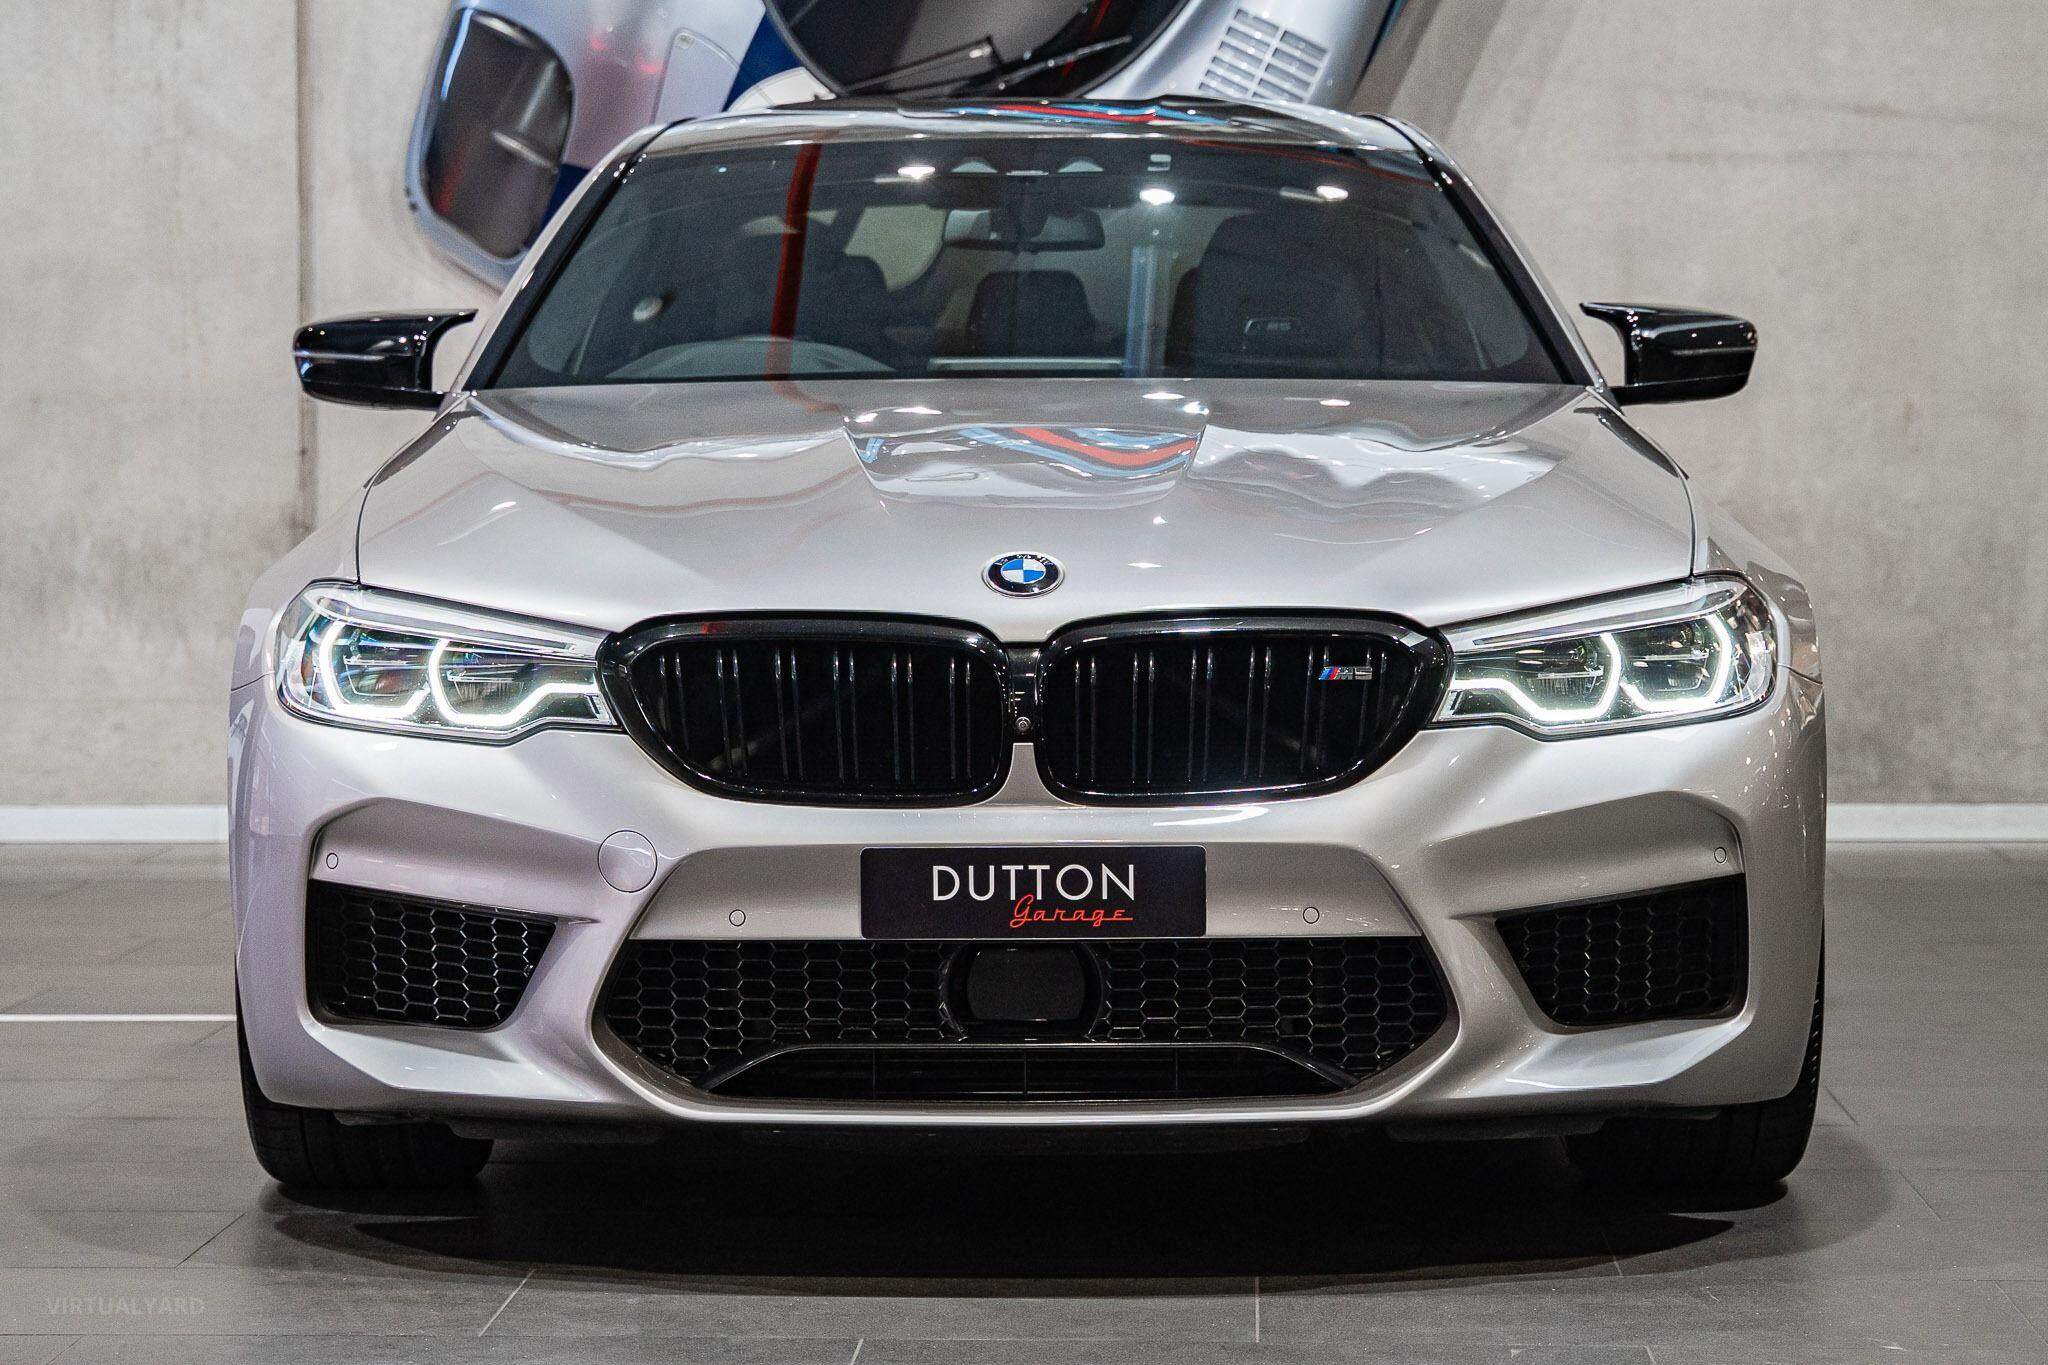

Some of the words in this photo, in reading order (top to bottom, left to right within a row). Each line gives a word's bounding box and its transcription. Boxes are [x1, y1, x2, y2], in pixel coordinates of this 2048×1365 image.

[1334, 666, 1373, 681] M5
[932, 863, 1136, 901] DUTTON
[1009, 894, 1134, 928] Garage
